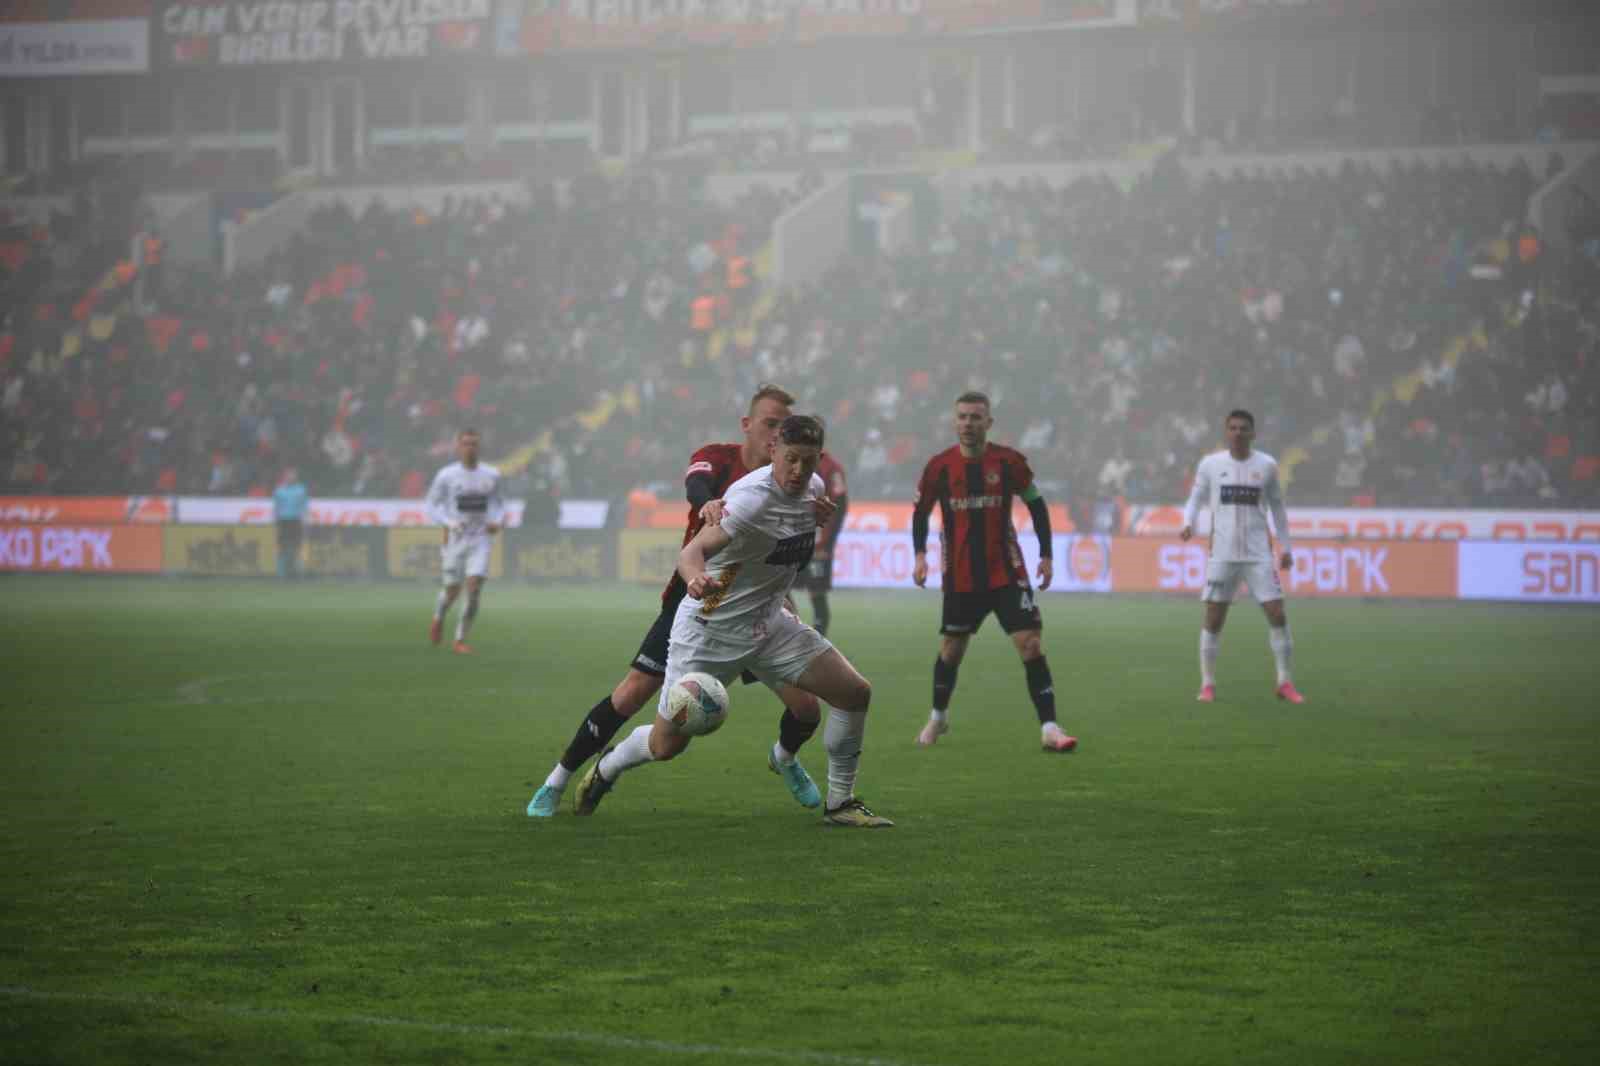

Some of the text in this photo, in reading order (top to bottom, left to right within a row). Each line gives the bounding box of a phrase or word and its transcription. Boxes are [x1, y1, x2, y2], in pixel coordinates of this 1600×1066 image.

[162, 5, 227, 33] CAN
[359, 24, 430, 57] VAR
[40, 528, 112, 568] park
[1291, 545, 1391, 592] park
